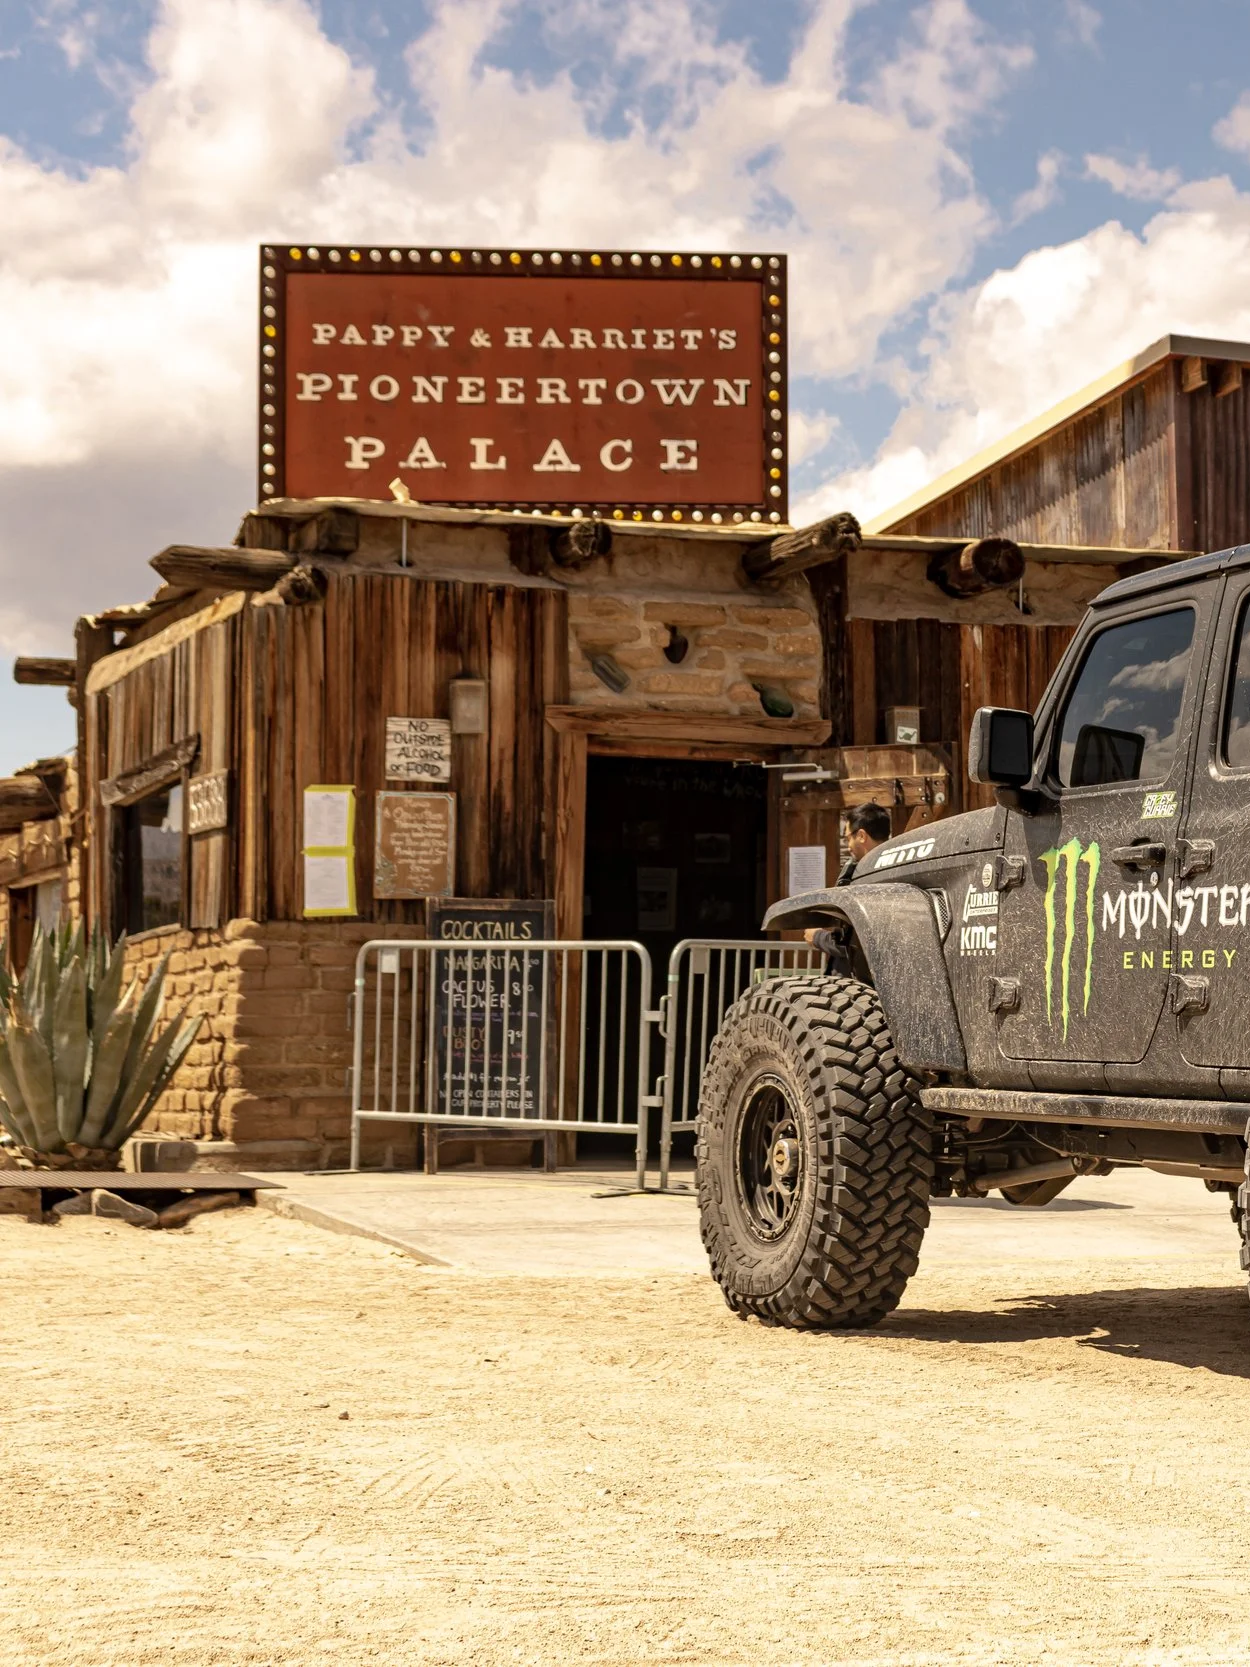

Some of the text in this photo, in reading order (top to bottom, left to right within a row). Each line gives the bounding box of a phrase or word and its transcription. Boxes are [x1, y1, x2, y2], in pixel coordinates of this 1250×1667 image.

[311, 323, 738, 351] PAPPY & HARRIET'S
[296, 372, 751, 407] PIONEERTOWN
[344, 436, 699, 473] PALACE
[408, 721, 429, 732] NO
[406, 762, 441, 776] FOOD
[441, 920, 532, 940] COCKTAILS
[961, 926, 997, 950] KMC
[1123, 949, 1236, 969] ENERGY
